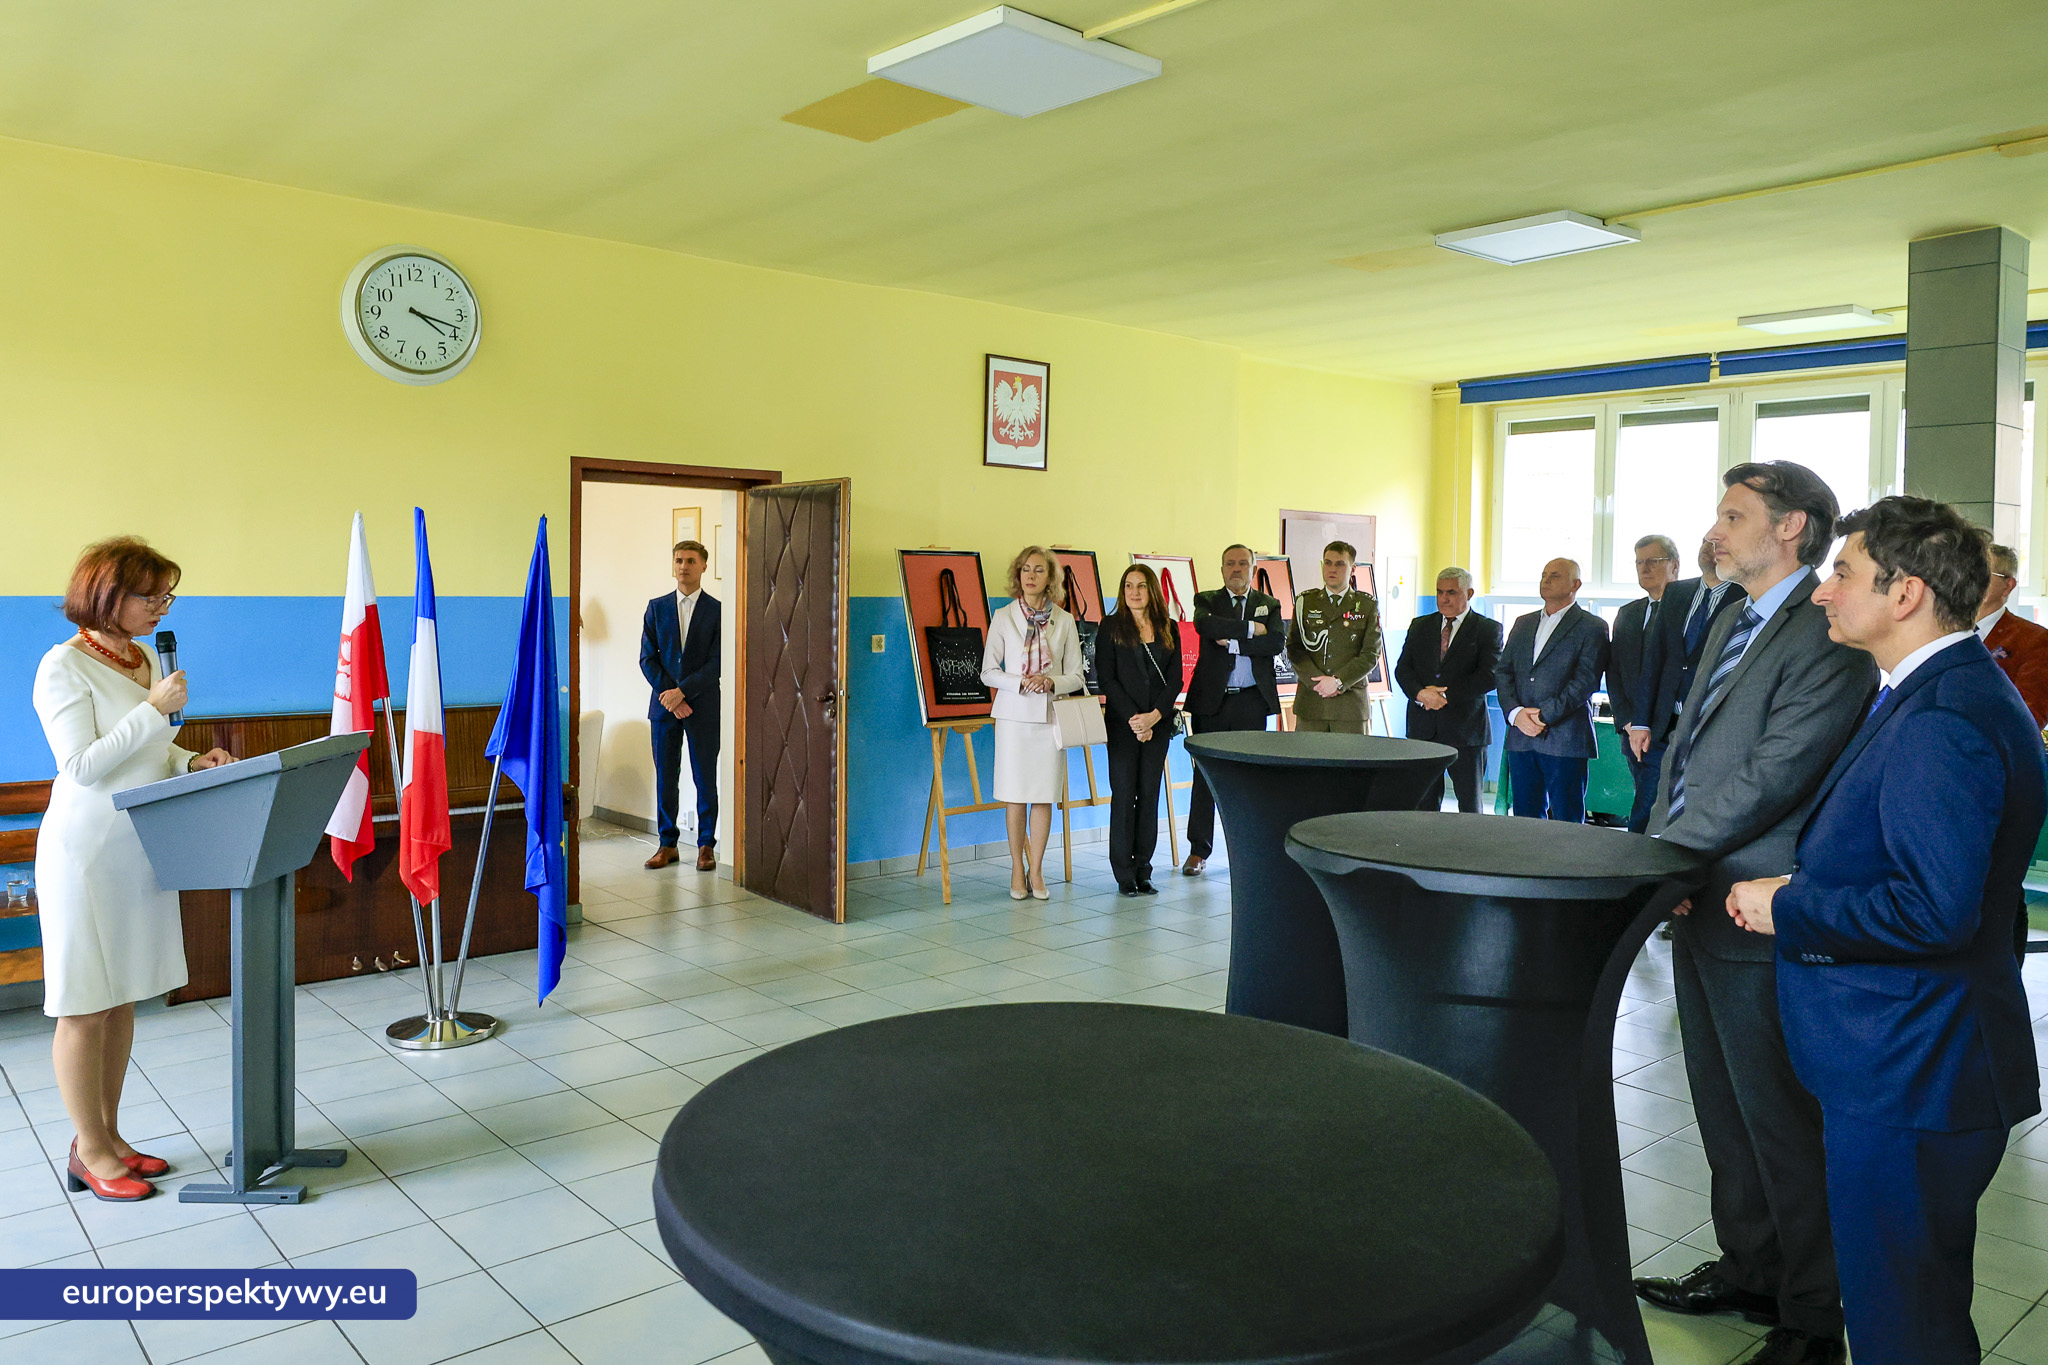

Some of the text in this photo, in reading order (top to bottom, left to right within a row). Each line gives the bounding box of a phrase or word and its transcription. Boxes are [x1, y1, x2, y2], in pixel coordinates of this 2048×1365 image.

[391, 273, 403, 288] 11
[407, 268, 424, 283] 12
[433, 274, 437, 288] 1
[377, 288, 393, 302] 10
[445, 287, 455, 301] 2
[370, 305, 382, 320] 9
[455, 308, 464, 322] 3
[379, 325, 390, 339] 8
[449, 328, 459, 341] 4
[397, 340, 406, 354] 7
[415, 345, 427, 360] 6
[437, 341, 447, 356] 5
